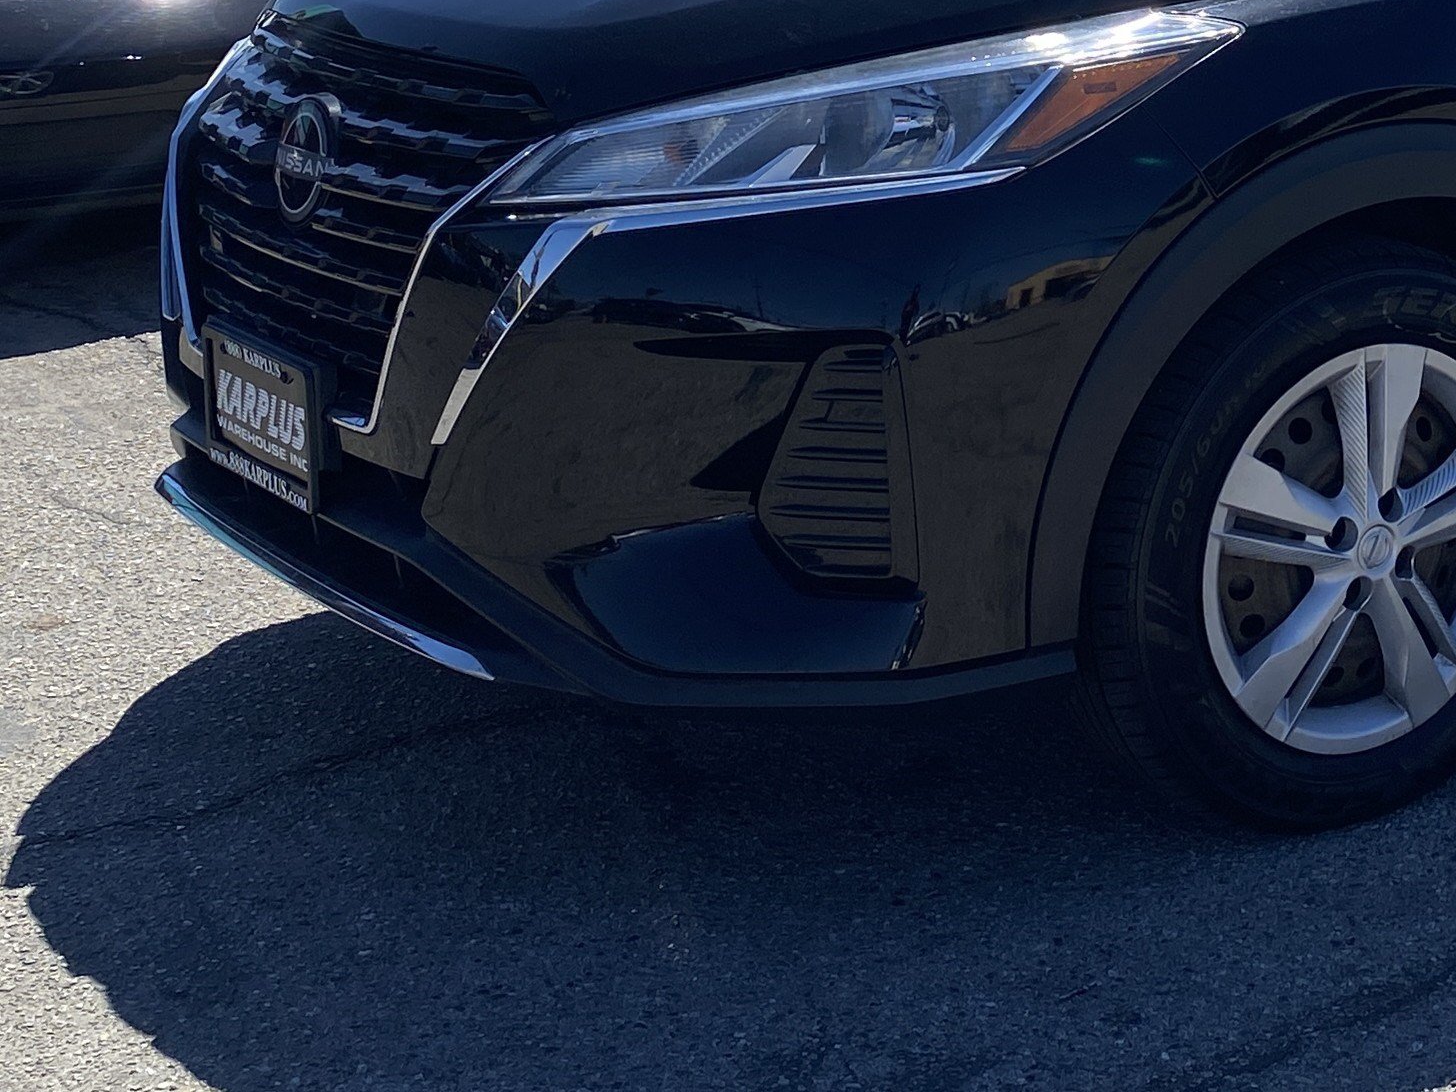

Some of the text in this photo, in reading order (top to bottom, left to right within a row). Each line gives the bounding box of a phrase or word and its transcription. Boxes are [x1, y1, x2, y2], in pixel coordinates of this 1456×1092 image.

[242, 347, 282, 380] KARPLUS
[216, 368, 306, 452] KARPLUS
[216, 412, 309, 473] WAREHOUSE INC
